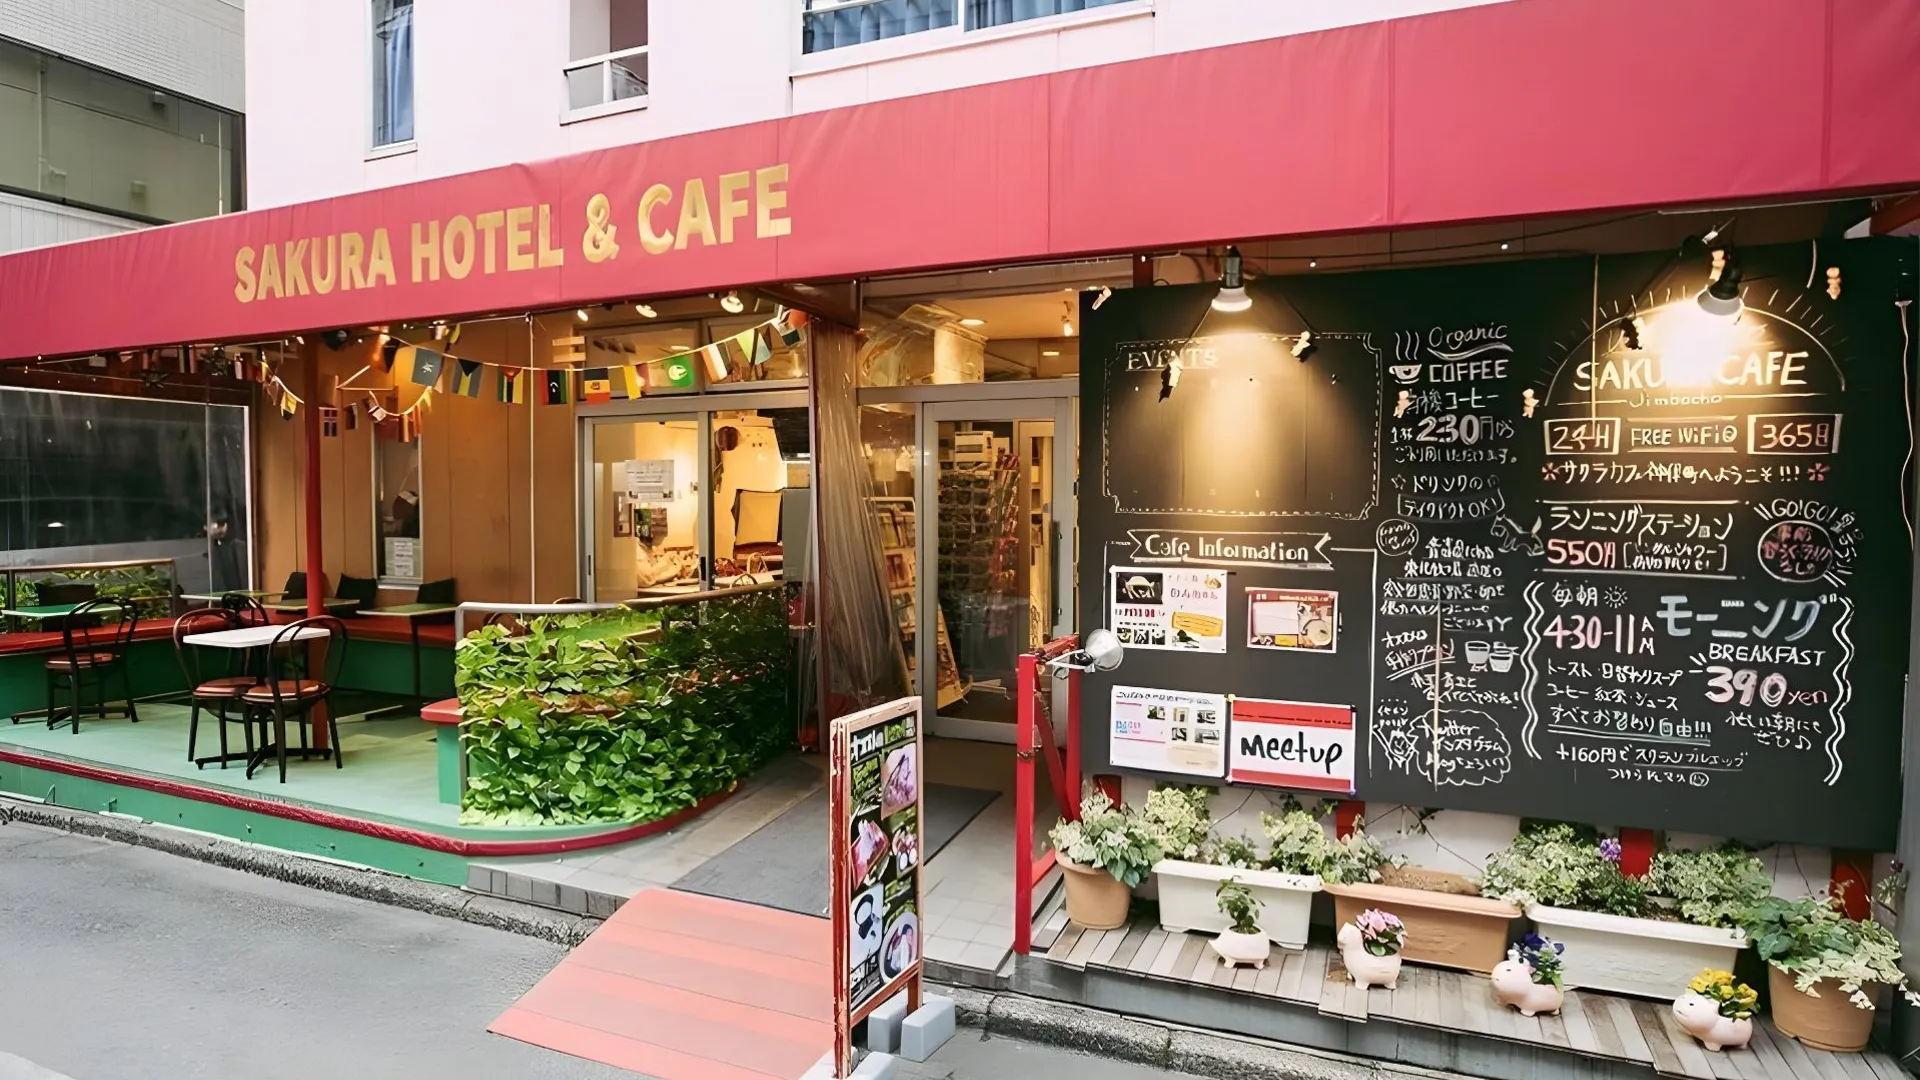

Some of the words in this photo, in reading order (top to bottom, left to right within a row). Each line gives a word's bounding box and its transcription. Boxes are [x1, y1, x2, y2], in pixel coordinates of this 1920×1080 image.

[234, 227, 396, 303] SAKURA
[411, 204, 564, 283] HOTEL
[582, 192, 619, 264] &
[638, 163, 793, 255] CAFE
[1429, 322, 1508, 350] Organic
[1428, 359, 1509, 383] COFFEE
[1572, 358, 1695, 392] SAKU
[1714, 350, 1810, 387] CAFE
[1628, 391, 1724, 409] Jimbocho
[1630, 427, 1672, 448] FREE
[1656, 593, 1838, 642] モーニング
[1708, 643, 1827, 666] BREAKFAST
[1240, 731, 1343, 774] Meetup
